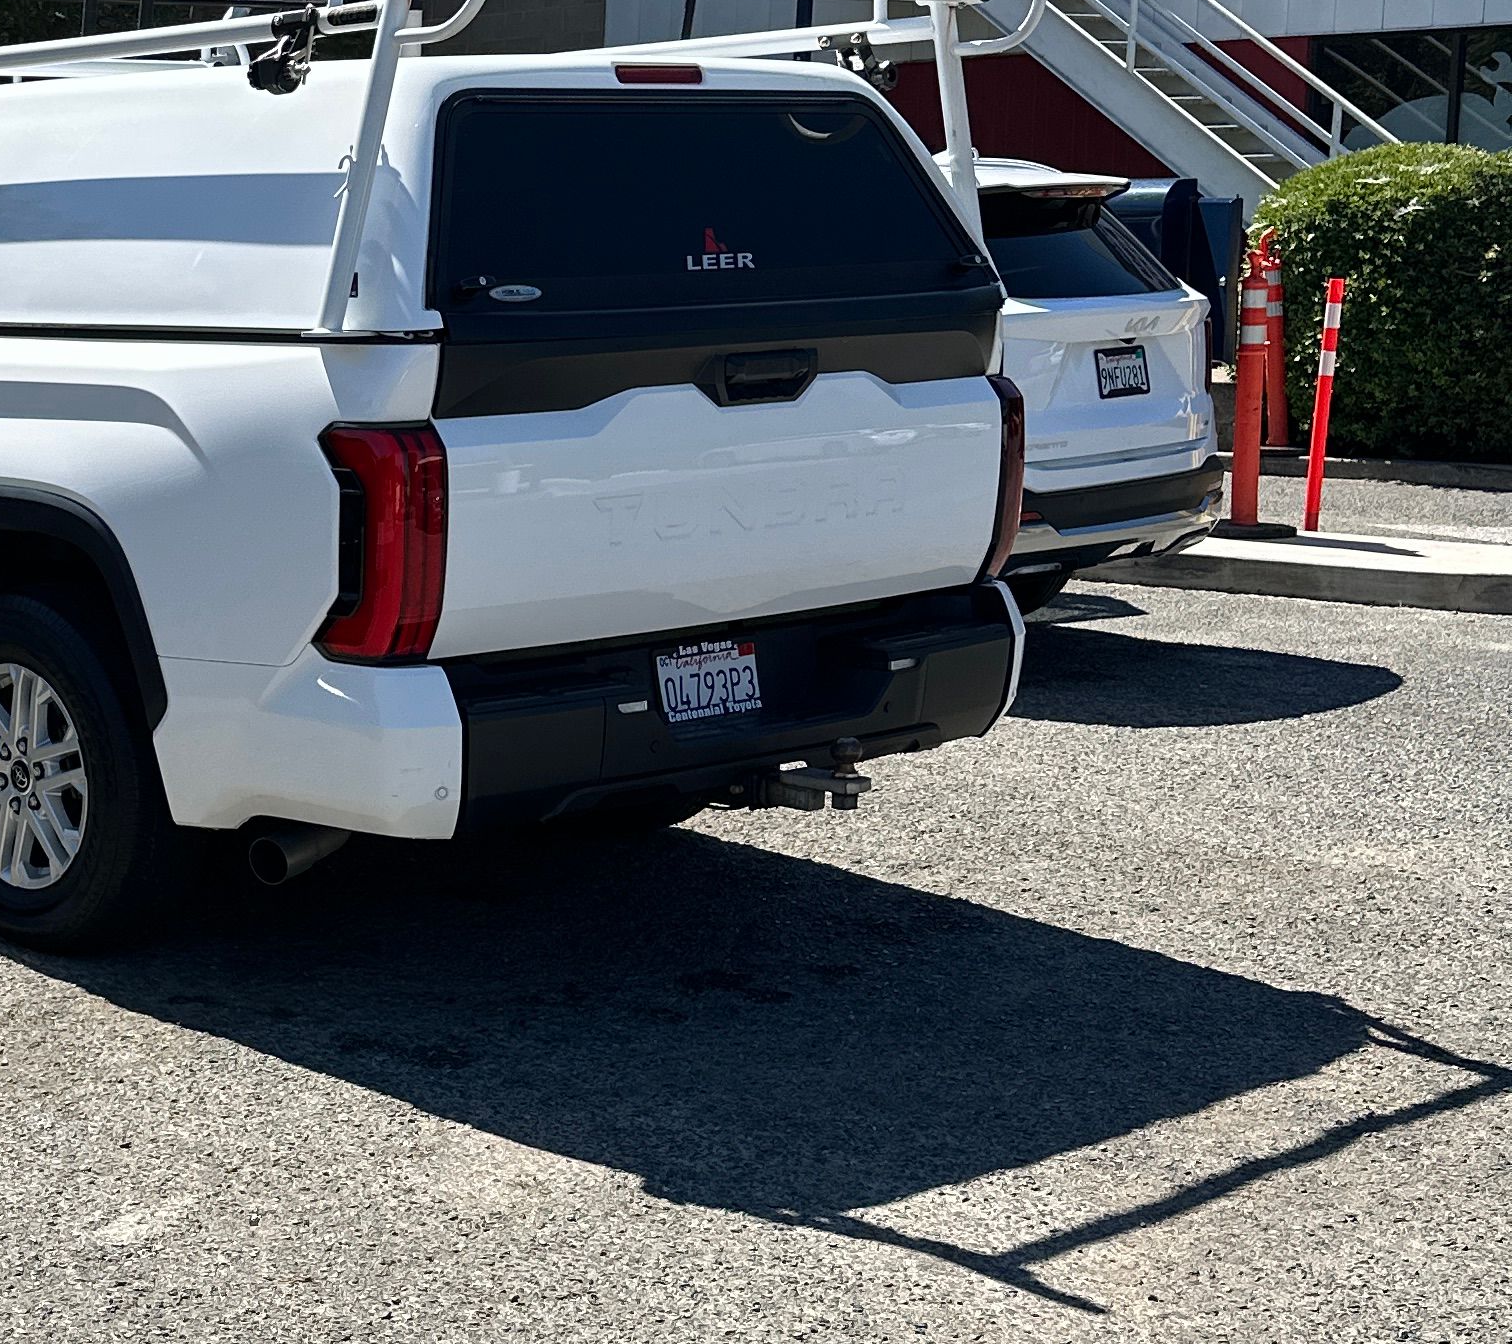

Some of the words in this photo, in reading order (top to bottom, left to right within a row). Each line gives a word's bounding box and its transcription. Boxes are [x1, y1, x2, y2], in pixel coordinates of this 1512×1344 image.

[686, 253, 755, 271] LEER
[1101, 365, 1145, 389] 9NFU281
[592, 477, 905, 547] TUNDRA
[679, 645, 699, 656] Las
[701, 640, 733, 653] Vegas
[668, 703, 725, 723] Centennial
[726, 699, 763, 714] Toyota
